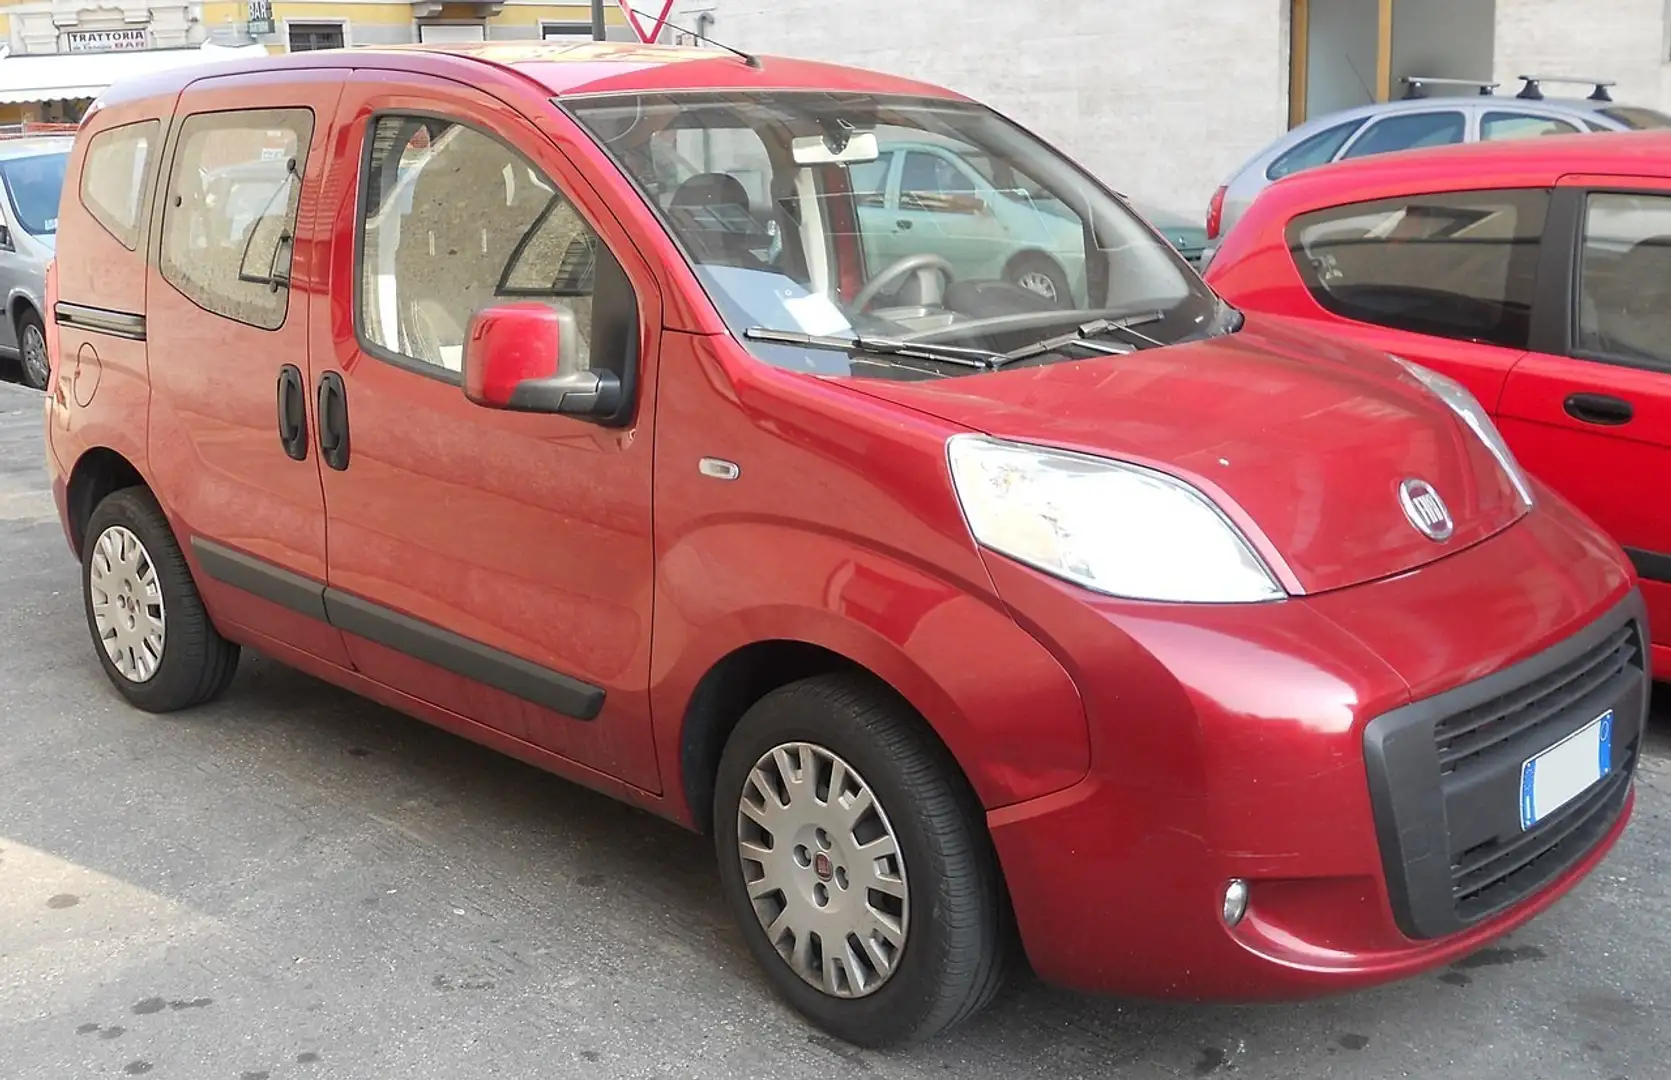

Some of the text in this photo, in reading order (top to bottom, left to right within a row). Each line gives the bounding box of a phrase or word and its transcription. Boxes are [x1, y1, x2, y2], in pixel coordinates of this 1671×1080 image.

[248, 1, 267, 20] BAR
[71, 31, 144, 42] TRATTORIA
[114, 41, 145, 49] BAR
